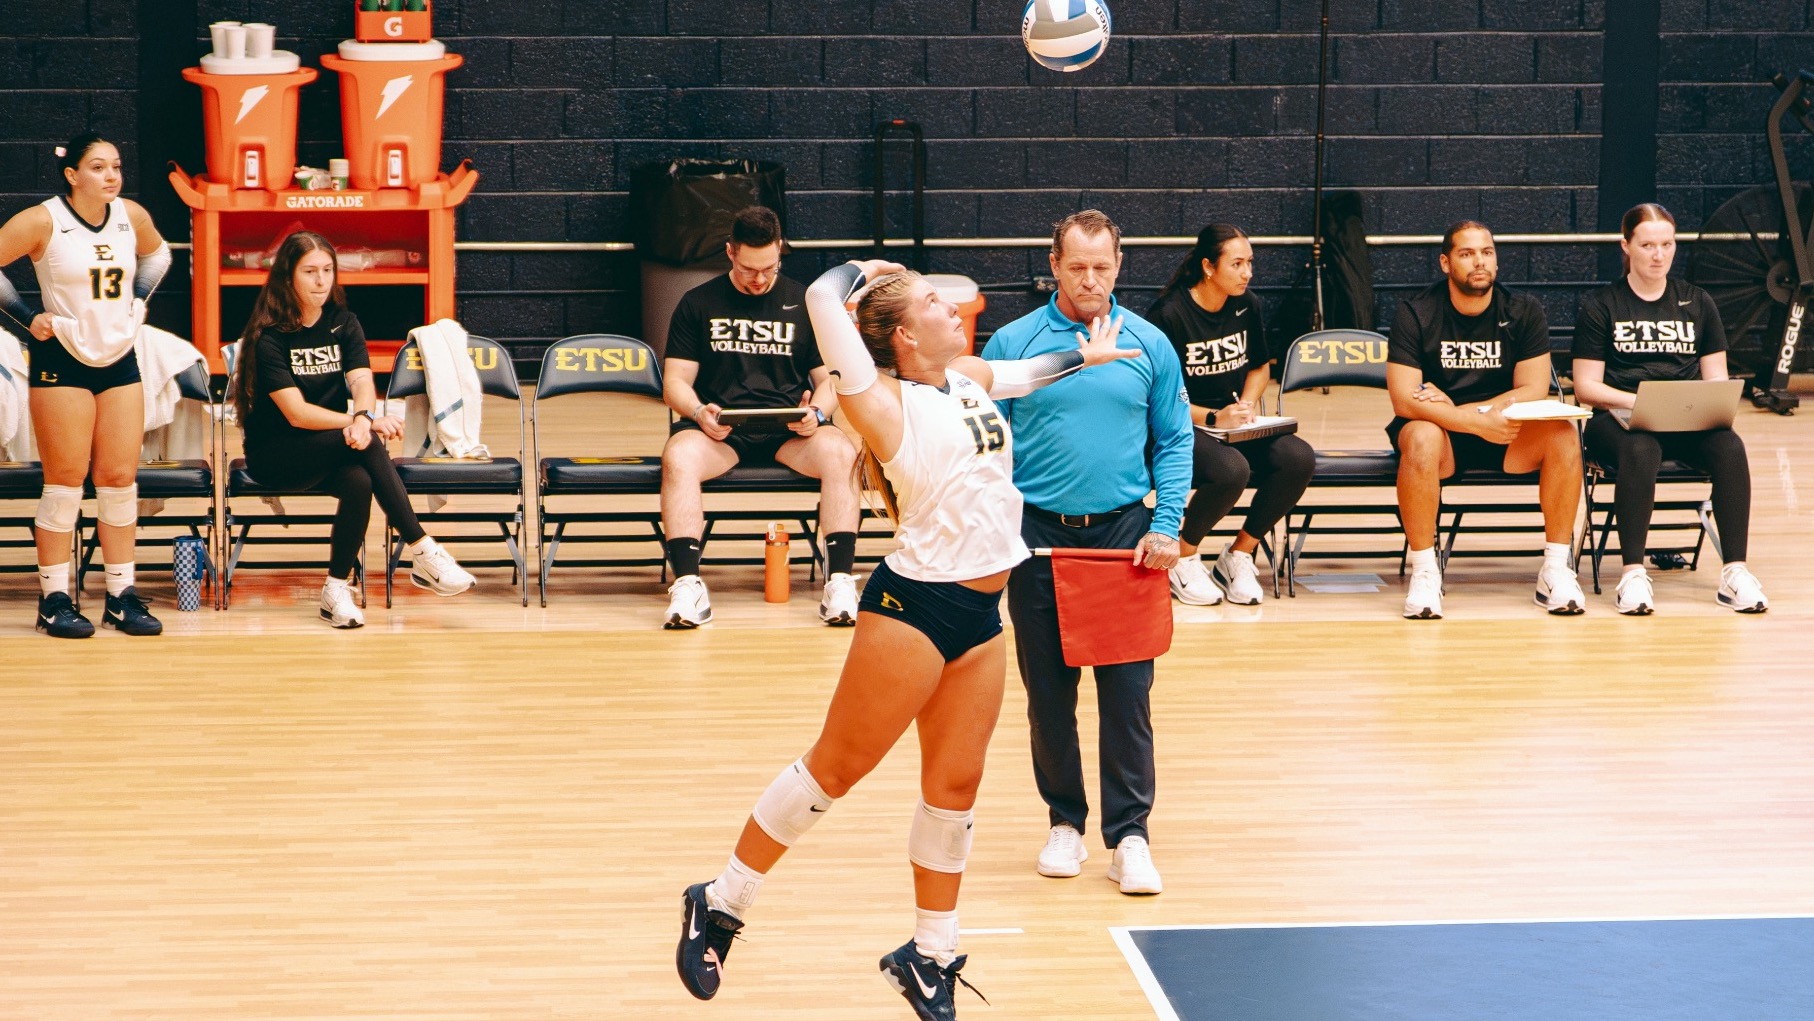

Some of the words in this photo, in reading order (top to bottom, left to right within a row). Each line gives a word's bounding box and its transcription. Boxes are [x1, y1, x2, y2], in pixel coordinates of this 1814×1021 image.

[384, 17, 402, 36] G
[286, 196, 363, 208] GATORADE
[93, 244, 114, 261] E
[88, 267, 124, 300] 13
[709, 318, 795, 344] ETSU
[1614, 320, 1696, 342] ETSU
[1777, 304, 1805, 374] ROGUE
[290, 344, 341, 366] ETSU
[405, 347, 498, 370] EU
[710, 340, 792, 356] VOLLEYBALL
[1185, 330, 1247, 365] ETSU
[1298, 340, 1389, 364] ETSU
[1440, 340, 1501, 359] ETSU
[1613, 341, 1696, 355] VOLLEYBALL
[291, 361, 342, 376] VOLLEYBALL
[555, 347, 647, 372] ETSU
[1185, 353, 1249, 377] VOLLEYBALL
[1440, 358, 1502, 369] VOLLEYBALL
[963, 411, 1006, 455] 15
